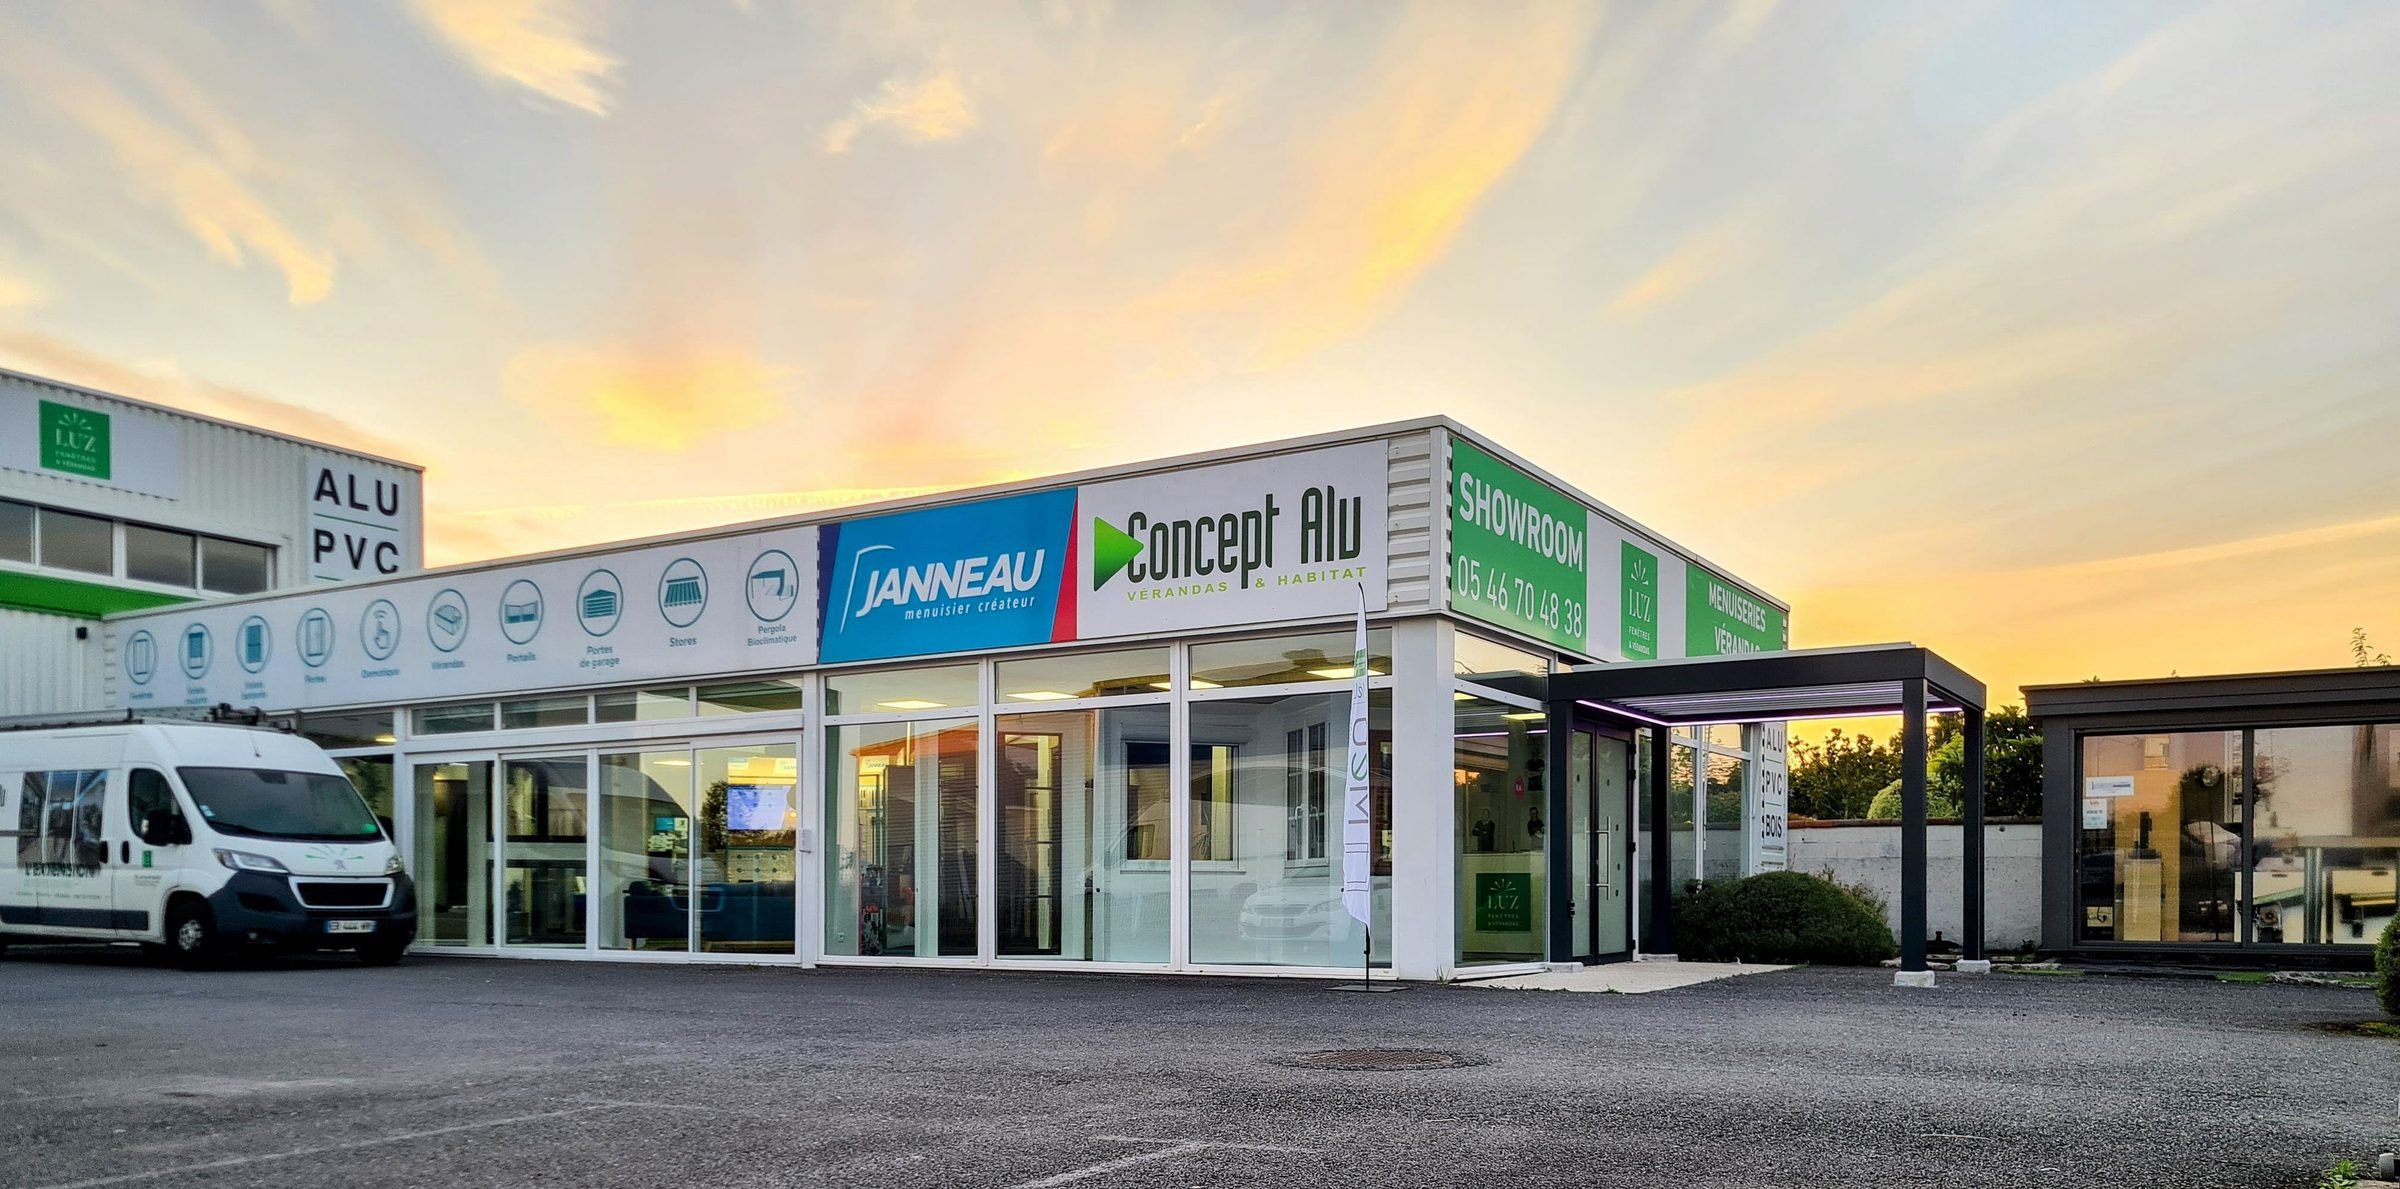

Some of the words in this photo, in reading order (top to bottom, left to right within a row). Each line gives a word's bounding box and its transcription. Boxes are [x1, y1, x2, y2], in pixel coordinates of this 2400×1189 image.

[56, 428, 96, 453] LUZ
[314, 468, 399, 517] ALU
[1459, 471, 1583, 573] SHOWROOM
[1127, 492, 1280, 590] Concept
[1300, 485, 1361, 563] Alu
[314, 528, 400, 574] PVC
[856, 548, 1045, 618] JANNEAU
[1127, 581, 1229, 602] VÉRANDAS
[1255, 577, 1266, 589] &
[1277, 566, 1367, 587] HABITAT
[905, 603, 971, 621] menuisier
[978, 596, 1035, 616] créateur
[1456, 554, 1480, 601] 05
[1486, 566, 1508, 612] 46
[1514, 578, 1534, 621] 70
[1540, 590, 1559, 631] 48
[1564, 600, 1582, 639] 38
[1629, 588, 1651, 623] LUZ
[1709, 581, 1766, 633] MENUISERIES
[747, 634, 797, 647] Bioclimatique
[758, 624, 786, 635] Pergola
[586, 645, 613, 655] Portes
[670, 637, 697, 648] Stores
[507, 650, 537, 663] Portails
[580, 658, 590, 668] de
[592, 658, 620, 669] garage
[1766, 728, 1782, 753] ALU
[1766, 770, 1782, 795] PVC
[1766, 814, 1782, 838] BOIS
[1488, 895, 1519, 909] LUZ
